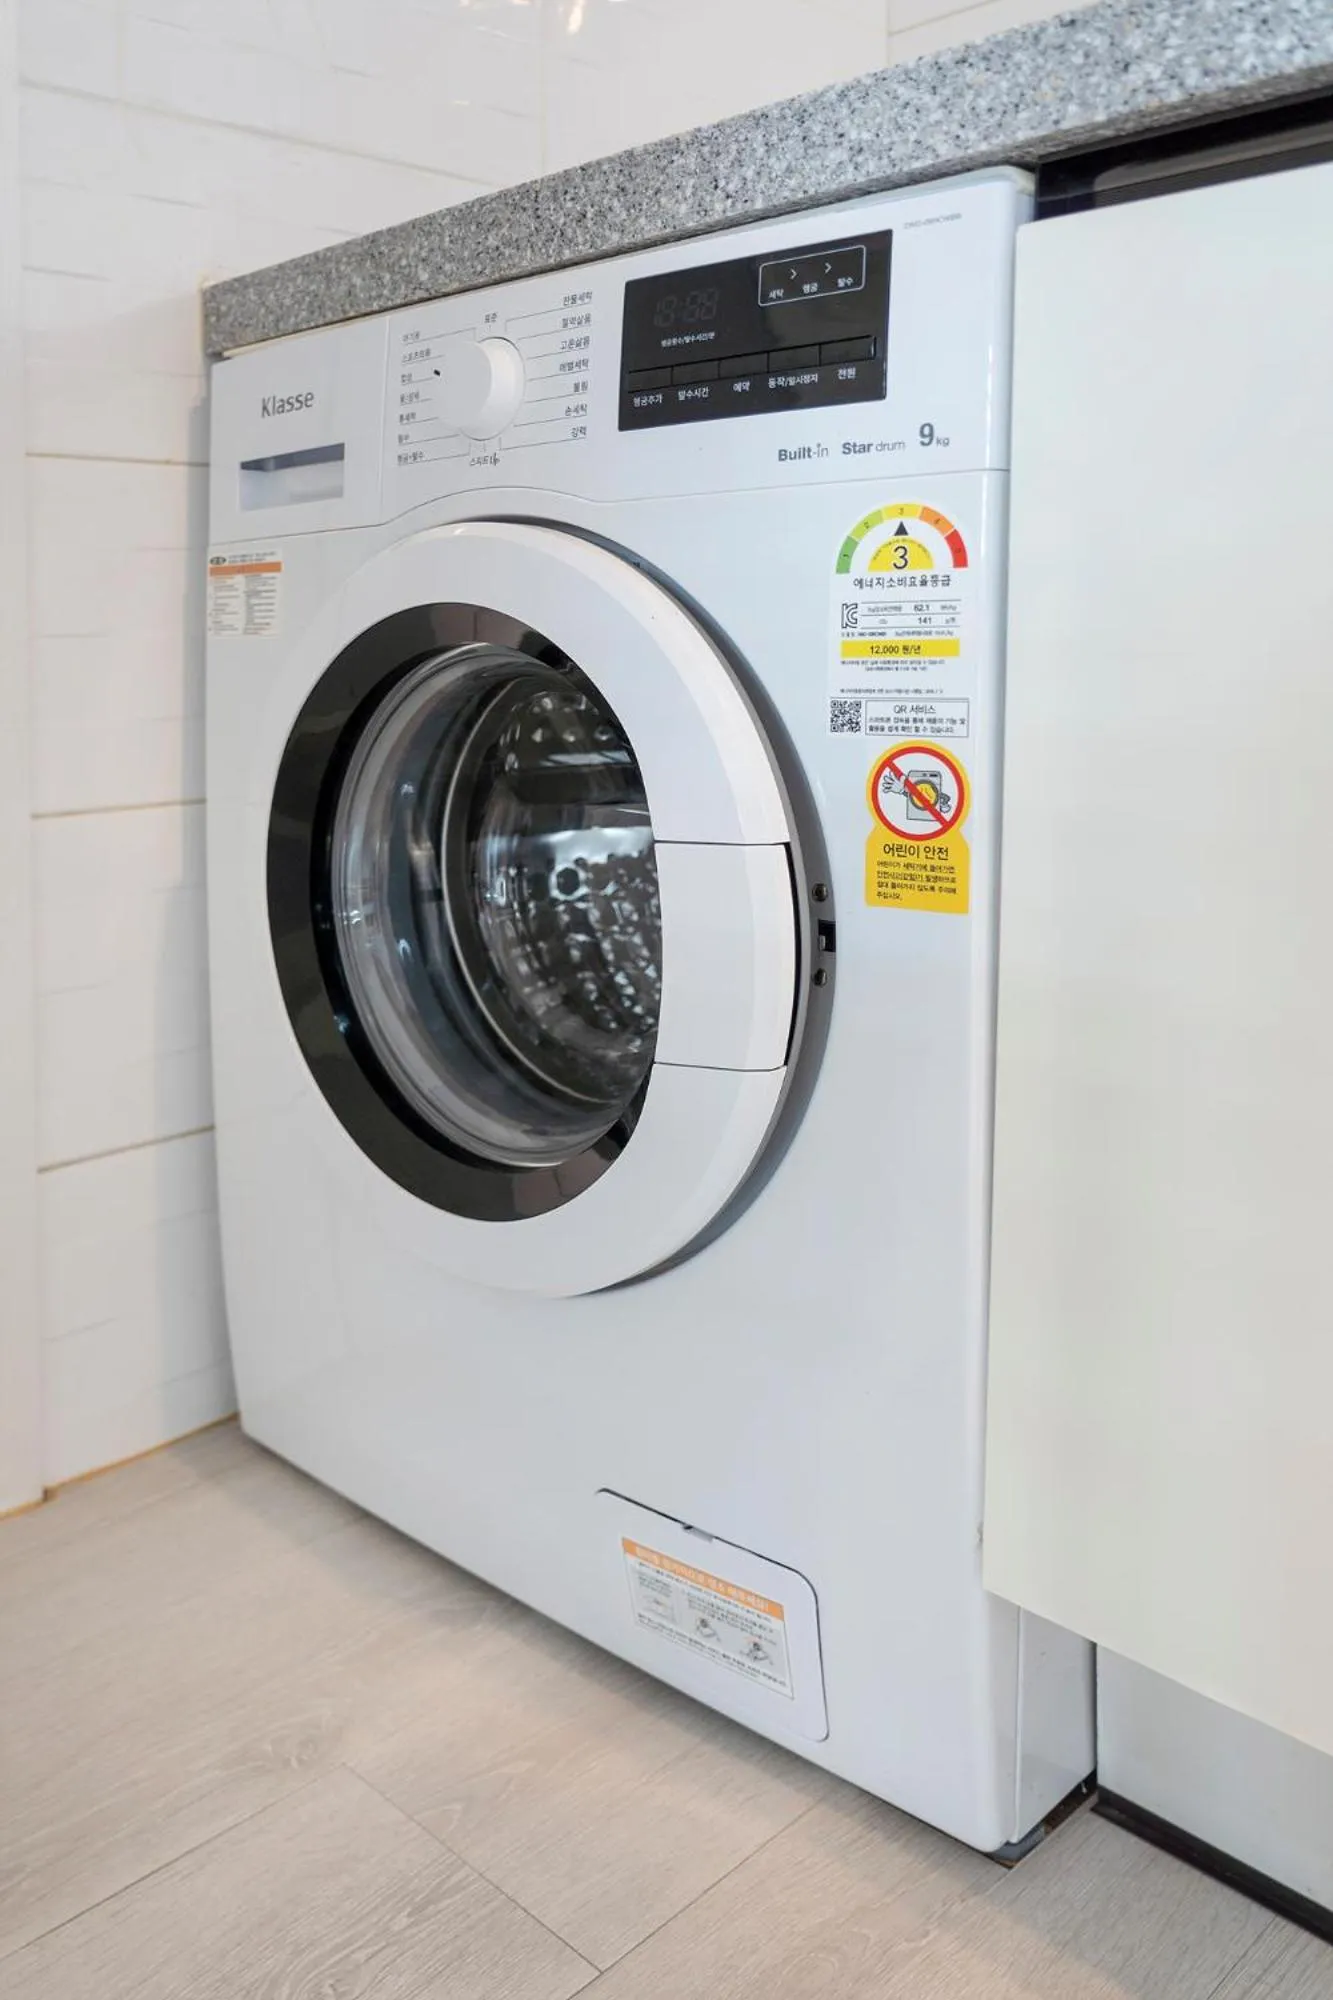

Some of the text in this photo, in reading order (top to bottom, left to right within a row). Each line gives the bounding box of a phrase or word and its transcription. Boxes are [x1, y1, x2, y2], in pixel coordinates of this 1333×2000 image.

[838, 367, 857, 380] 전원
[733, 380, 751, 392] 예약
[261, 391, 315, 419] Klasse
[778, 443, 829, 462] Built-in
[841, 441, 874, 456] Star
[892, 545, 909, 570] 3
[853, 574, 951, 590] 에너지소비효율등급
[914, 604, 930, 612] 62.1
[917, 616, 932, 625] 141
[894, 705, 936, 714] QR 서비스
[883, 843, 949, 861] 어린이 안전
